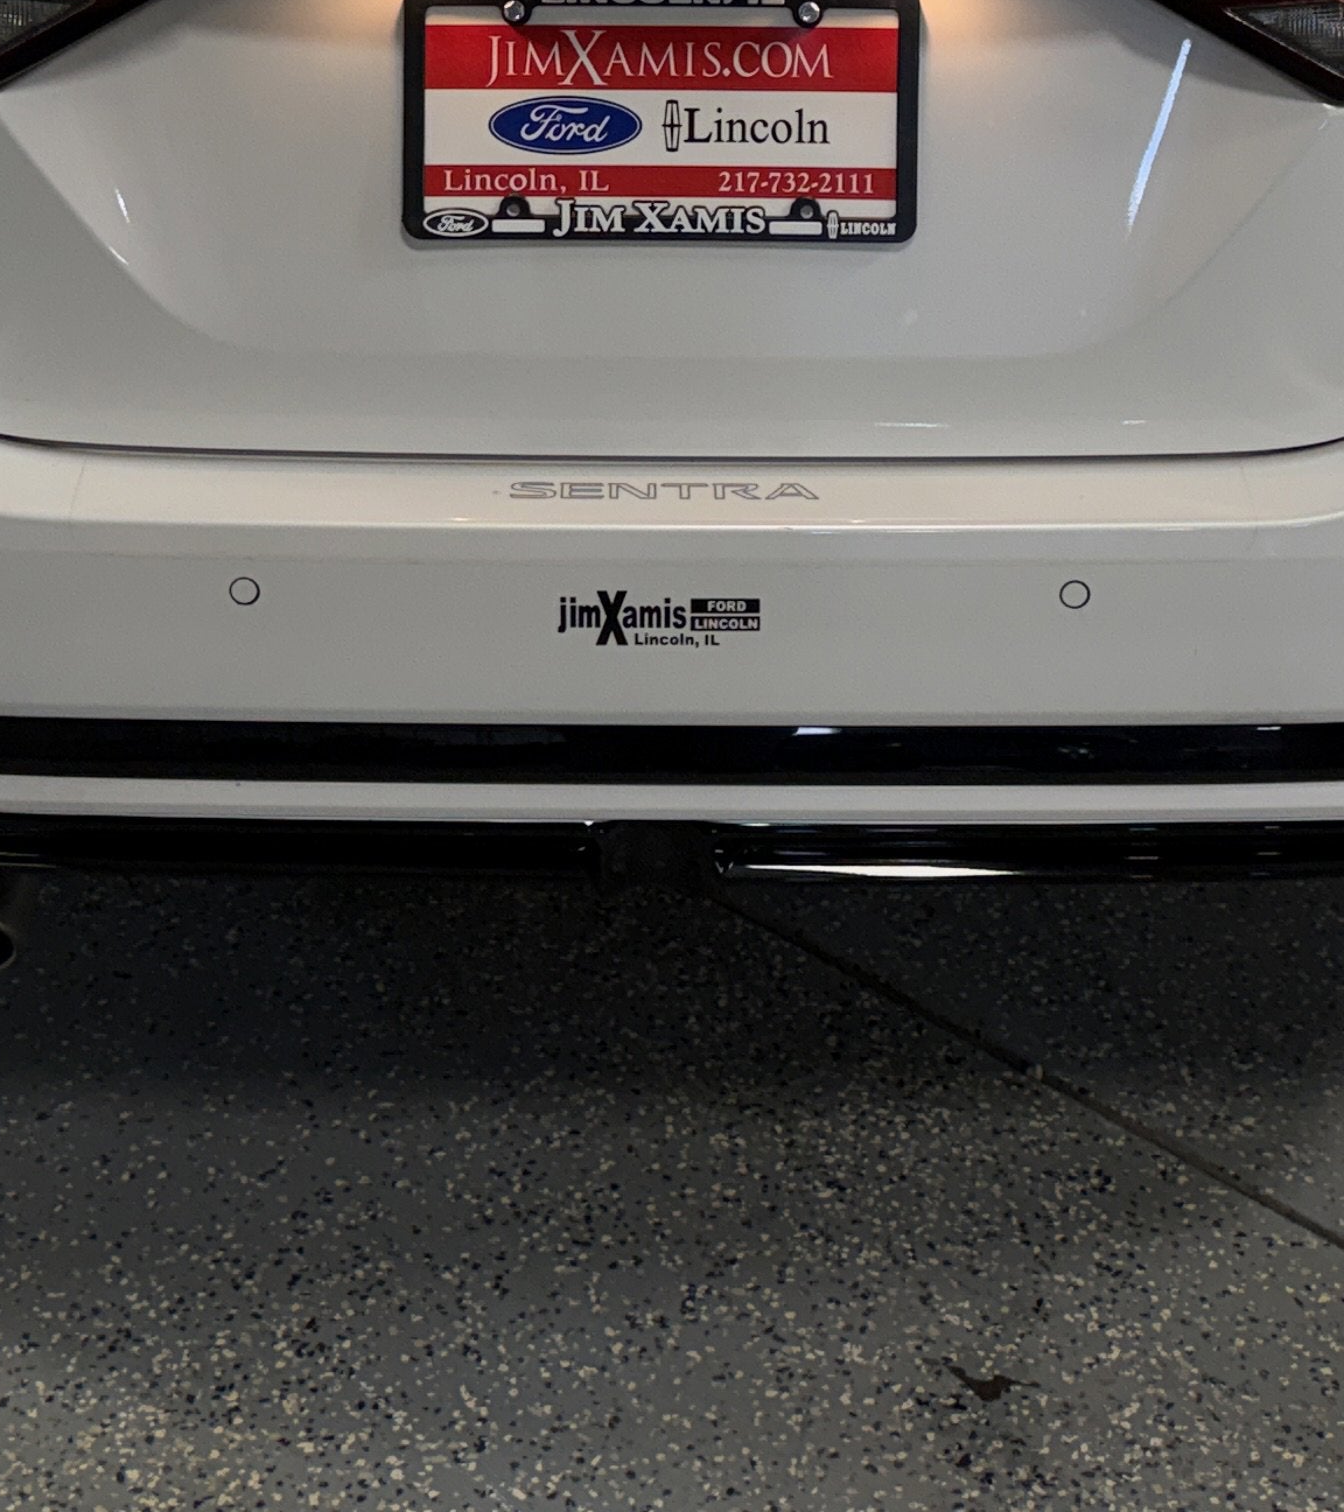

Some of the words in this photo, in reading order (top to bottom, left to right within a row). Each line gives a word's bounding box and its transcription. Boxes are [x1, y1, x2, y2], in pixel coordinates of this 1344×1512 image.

[519, 105, 610, 144] Ford
[684, 107, 831, 145] Lincoln
[443, 168, 569, 196] Lincoln,
[578, 169, 610, 192] IL
[717, 171, 875, 195] 217-732-2111
[436, 215, 476, 233] Ford
[552, 197, 626, 238] JIM
[631, 202, 767, 235] XAMIS
[839, 221, 897, 236] LINCOLN
[508, 480, 821, 501] SENTRA
[706, 600, 748, 613] FORD
[693, 618, 760, 631] LINCOLN
[633, 632, 701, 649] Lincoln,
[704, 633, 721, 647] IL
